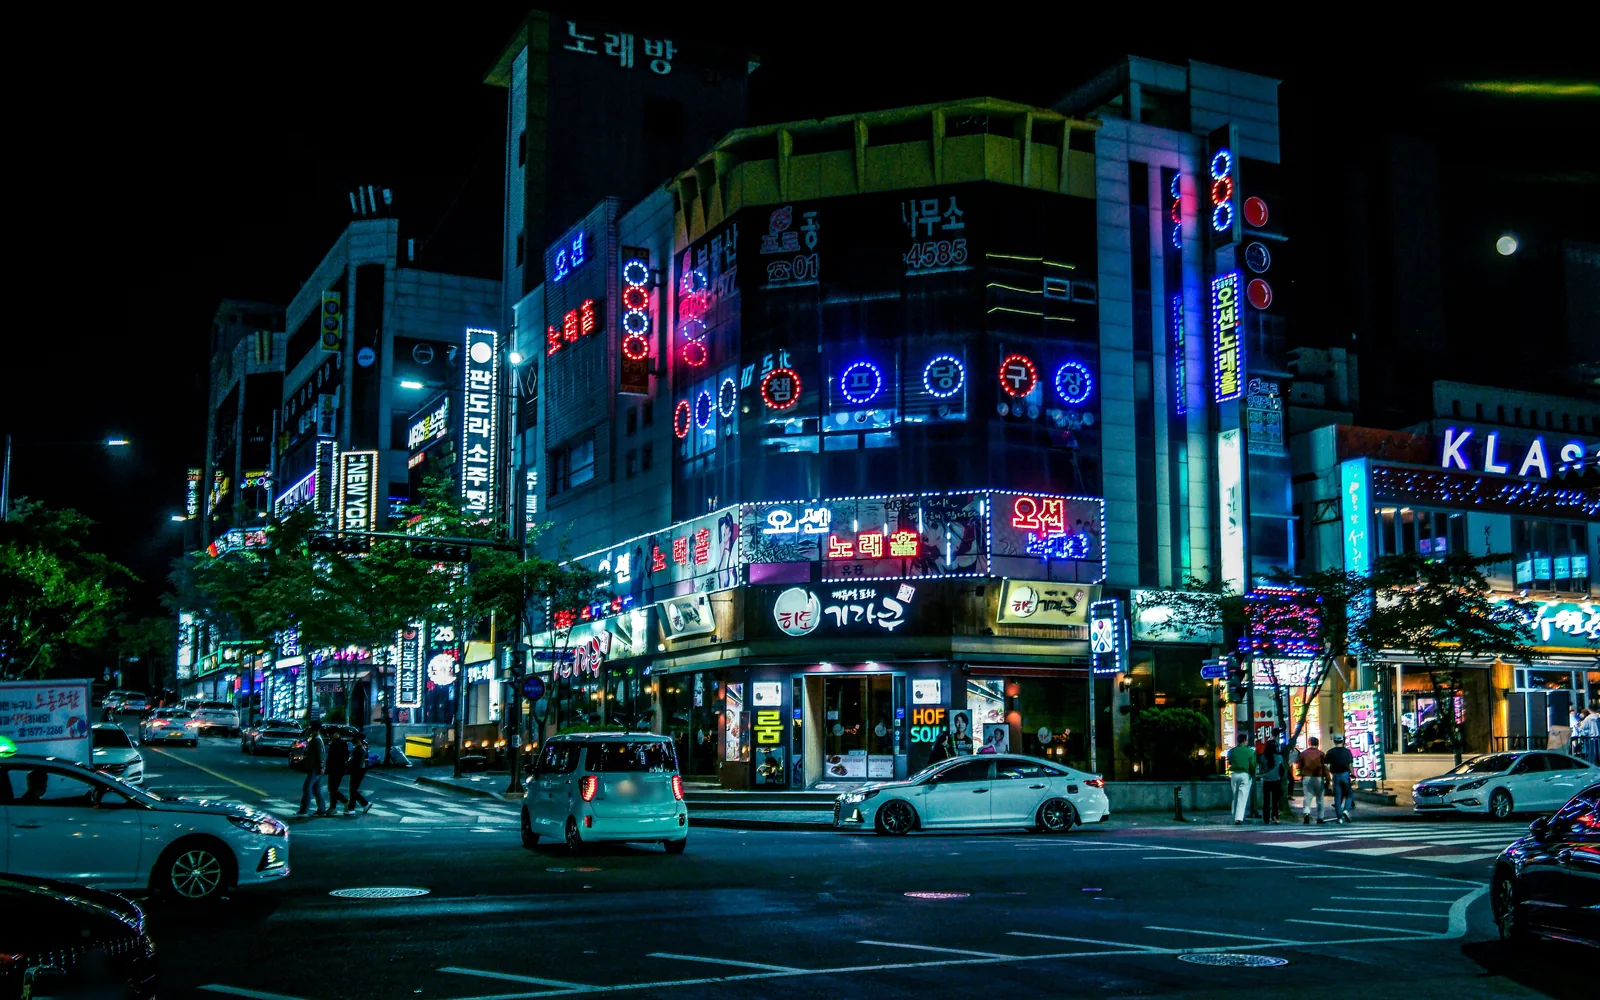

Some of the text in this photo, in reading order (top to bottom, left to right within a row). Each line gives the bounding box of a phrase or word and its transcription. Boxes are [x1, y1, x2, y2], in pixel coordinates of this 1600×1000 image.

[563, 20, 678, 75] 노래방
[906, 238, 968, 268] 4585
[1442, 429, 1600, 478] KLAS
[346, 463, 369, 496] NEW
[652, 528, 712, 573] 노래홀
[828, 531, 918, 558] 노래홀
[753, 709, 785, 745] 룸
[912, 707, 946, 725] HOF
